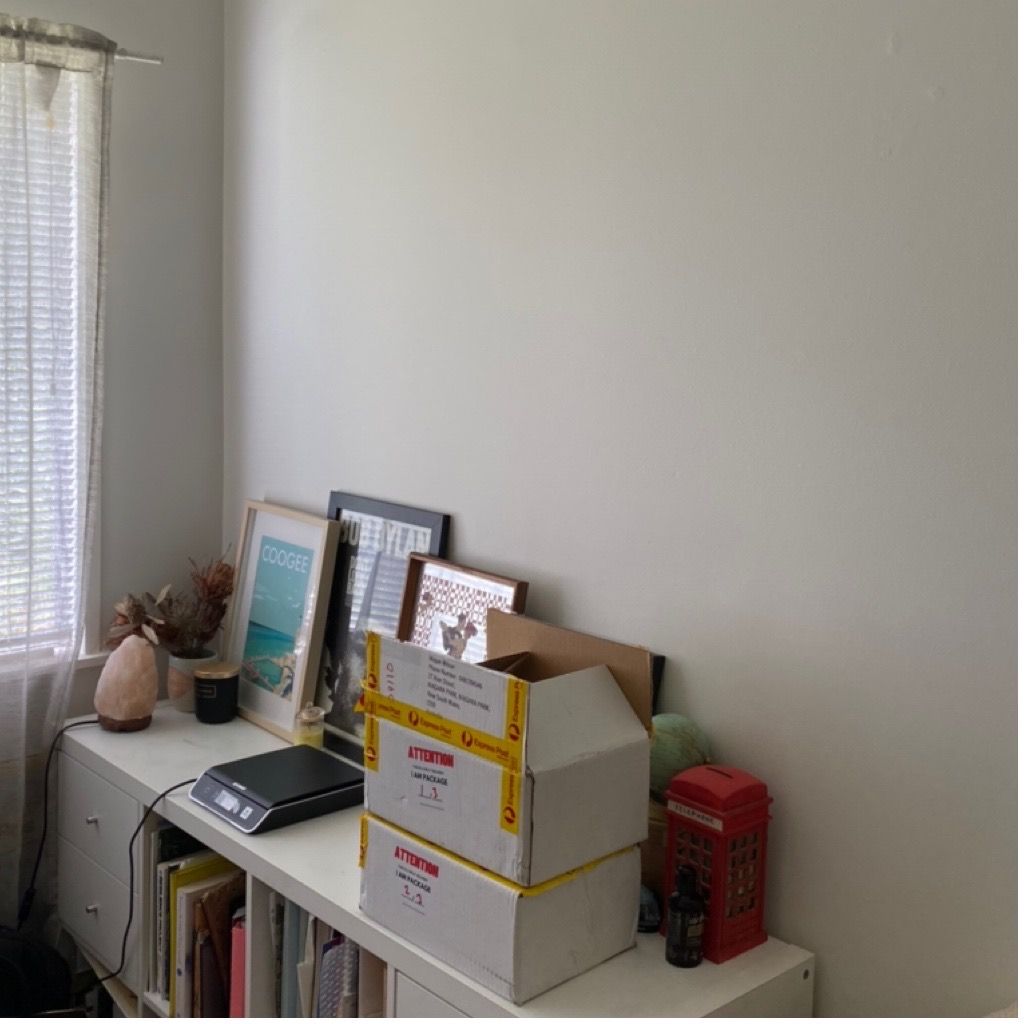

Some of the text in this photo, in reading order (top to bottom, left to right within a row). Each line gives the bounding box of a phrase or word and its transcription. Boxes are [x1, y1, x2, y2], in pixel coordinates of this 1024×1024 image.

[262, 545, 310, 574] COOGEE
[407, 745, 455, 768] ATTENTION
[423, 774, 448, 787] PACKAGE
[394, 846, 440, 878] ATTENTION
[407, 875, 431, 893] PACKAGE
